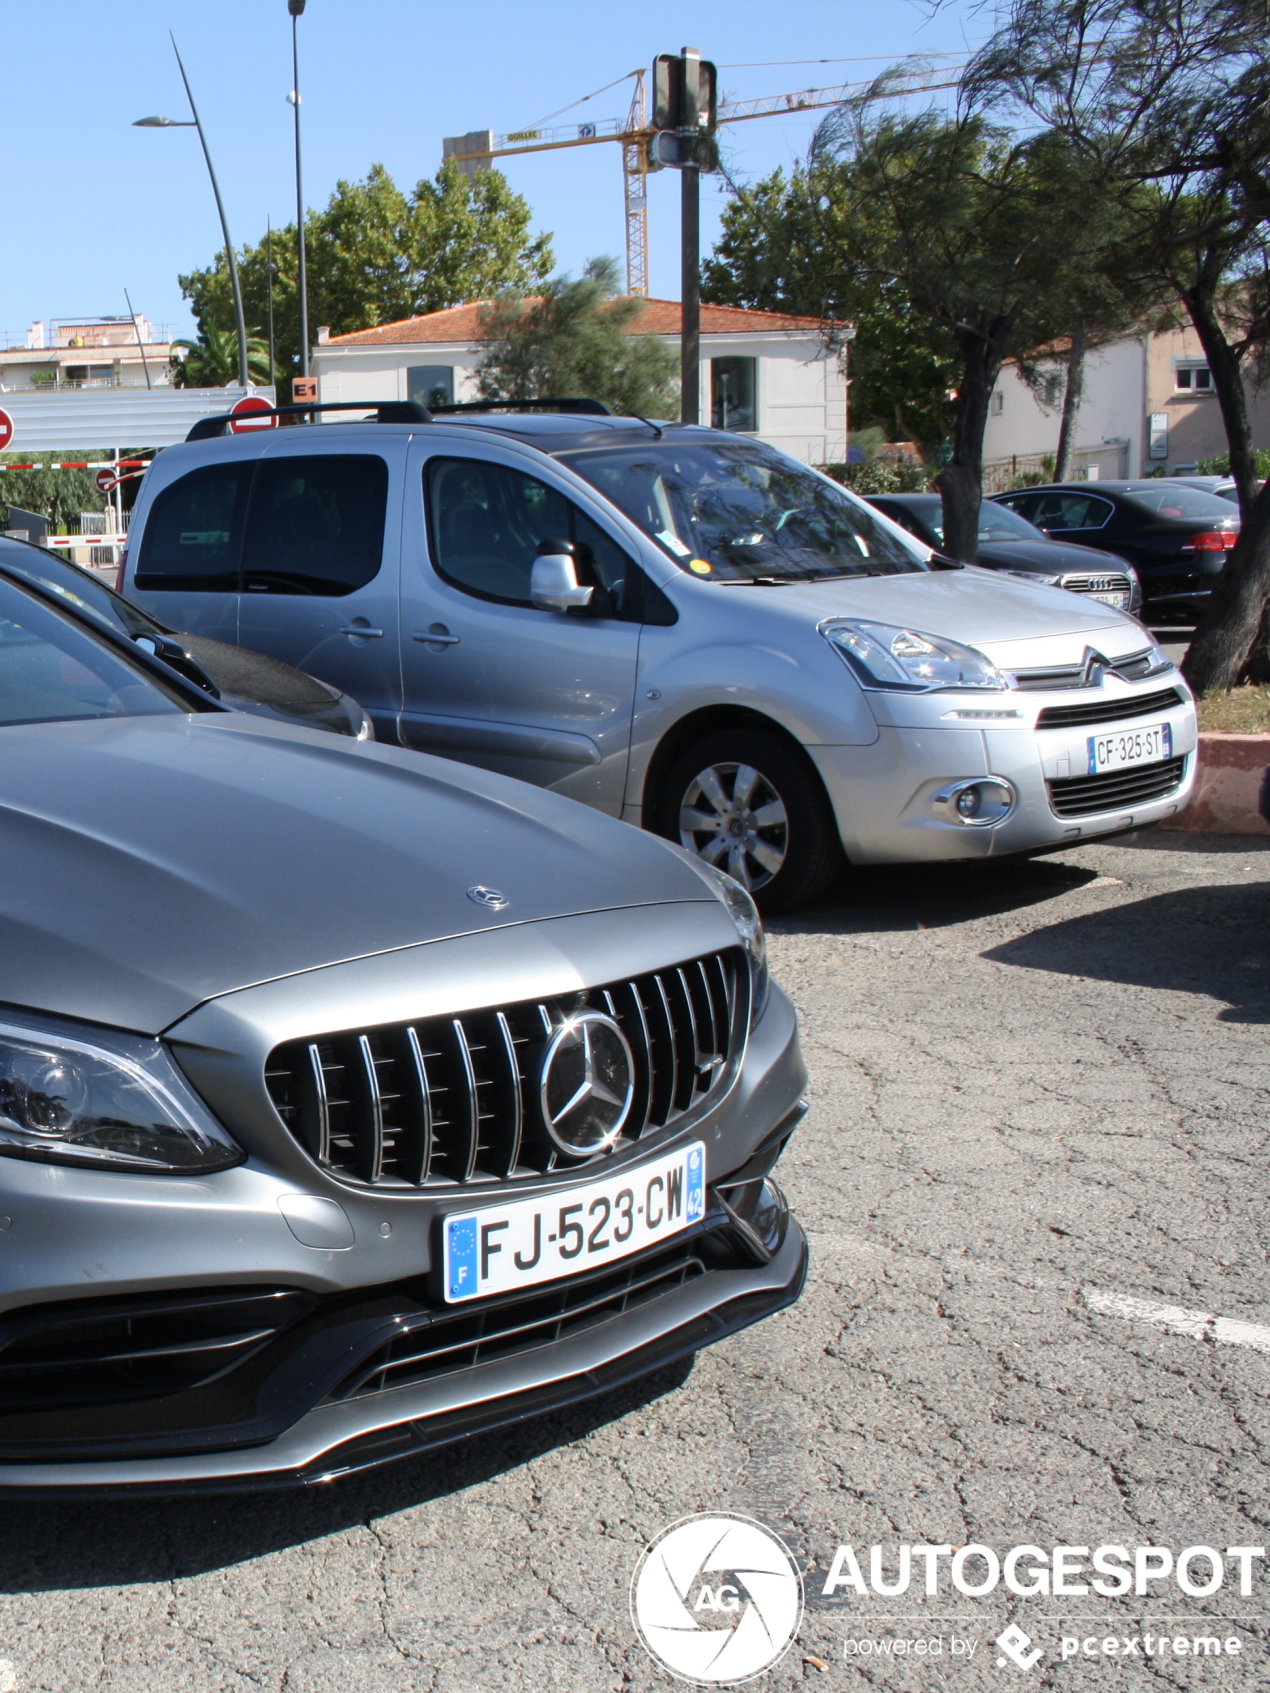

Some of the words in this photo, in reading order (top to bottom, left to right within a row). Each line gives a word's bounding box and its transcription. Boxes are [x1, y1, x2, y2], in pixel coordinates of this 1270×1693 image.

[294, 384, 316, 396] E1
[1097, 730, 1160, 765] CF-325-ST
[687, 1188, 701, 1216] 42
[481, 1165, 683, 1280] FJ-523-CW
[458, 1266, 468, 1284] F
